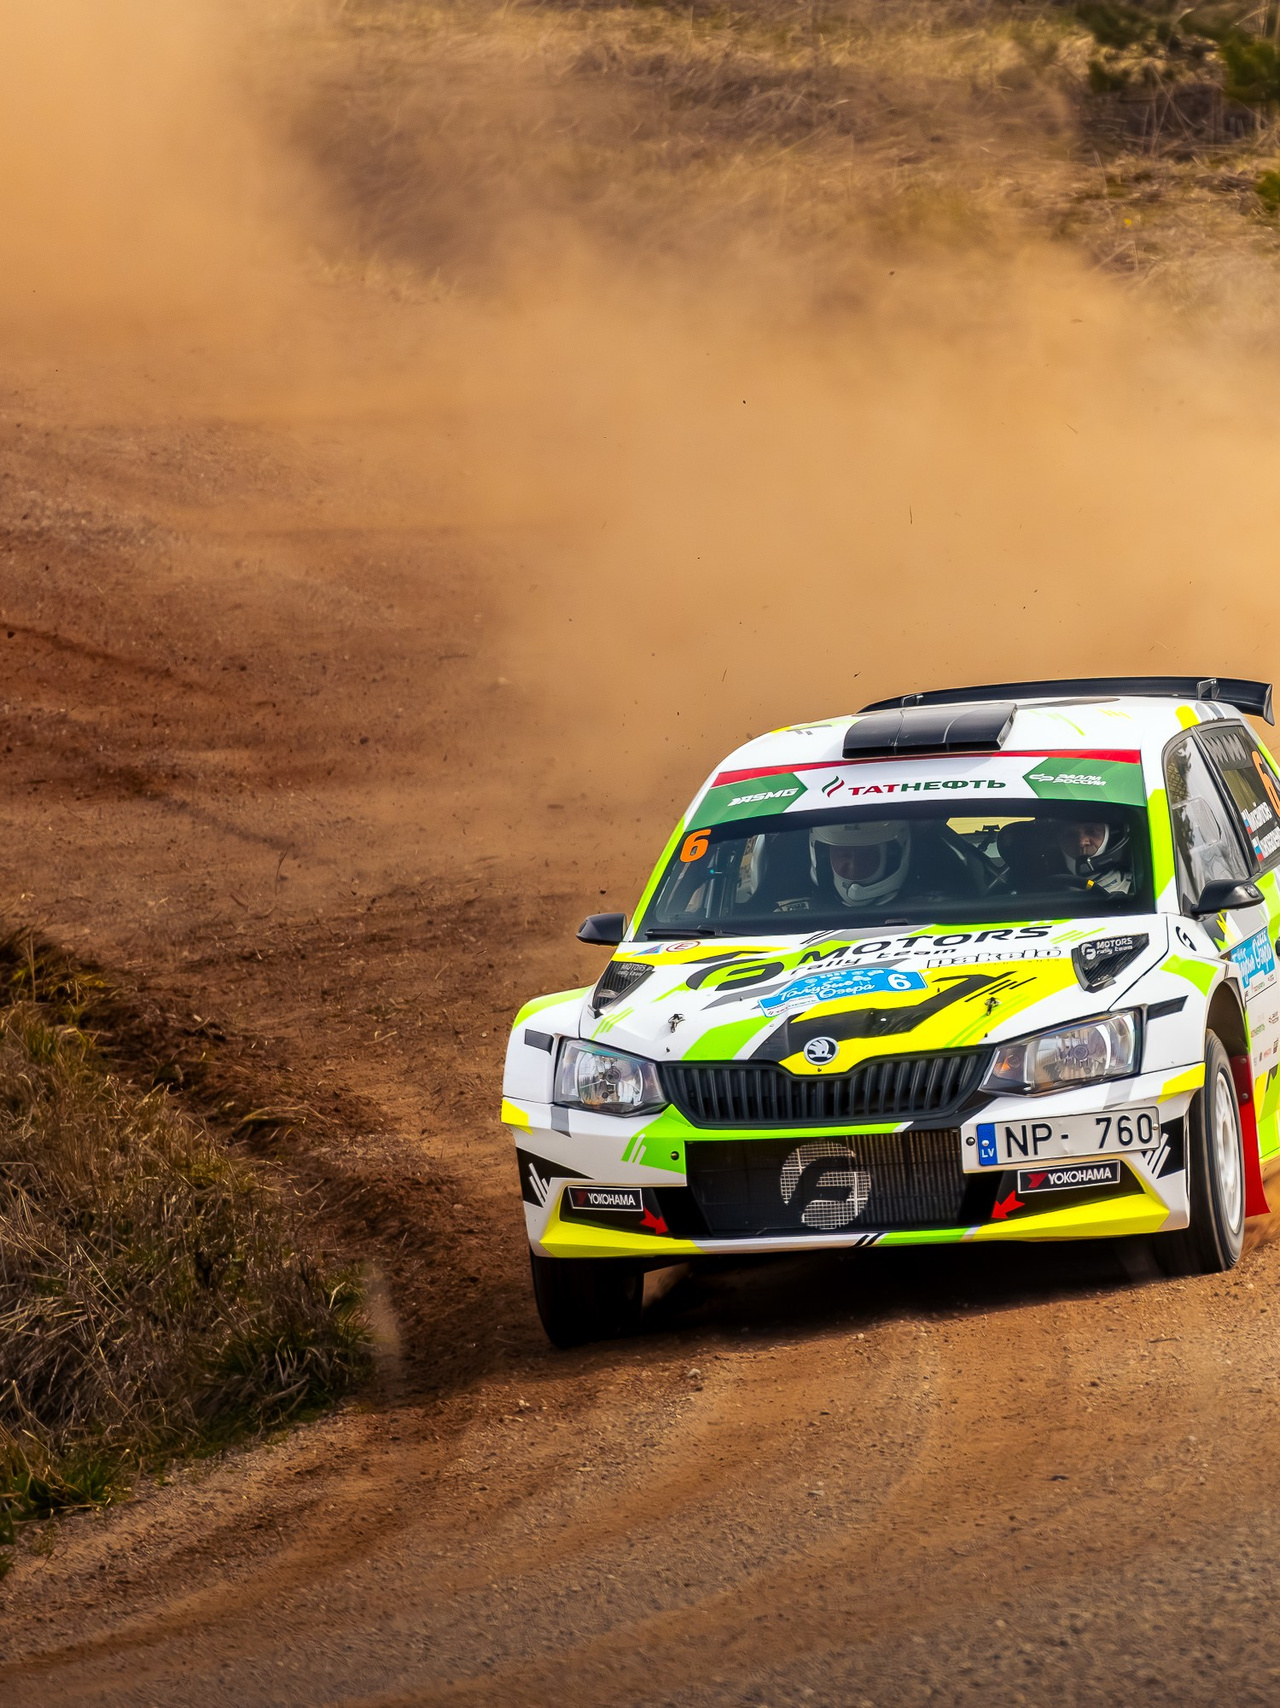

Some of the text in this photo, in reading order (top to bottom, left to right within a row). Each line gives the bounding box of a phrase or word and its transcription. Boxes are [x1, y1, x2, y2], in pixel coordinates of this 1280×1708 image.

[848, 779, 1007, 796] ТАТНЕФТЬ
[680, 828, 712, 863] 6
[797, 925, 1053, 967] MOTORS
[1096, 937, 1133, 950] MOTORS
[790, 957, 862, 976] rally
[877, 949, 957, 959] team
[927, 948, 1062, 969] pakelo
[887, 973, 912, 990] 6
[1095, 1112, 1153, 1150] 760
[981, 1147, 995, 1158] LV
[1048, 1167, 1112, 1185] YOKOHAMA
[587, 1193, 636, 1206] YOKOHAMA
